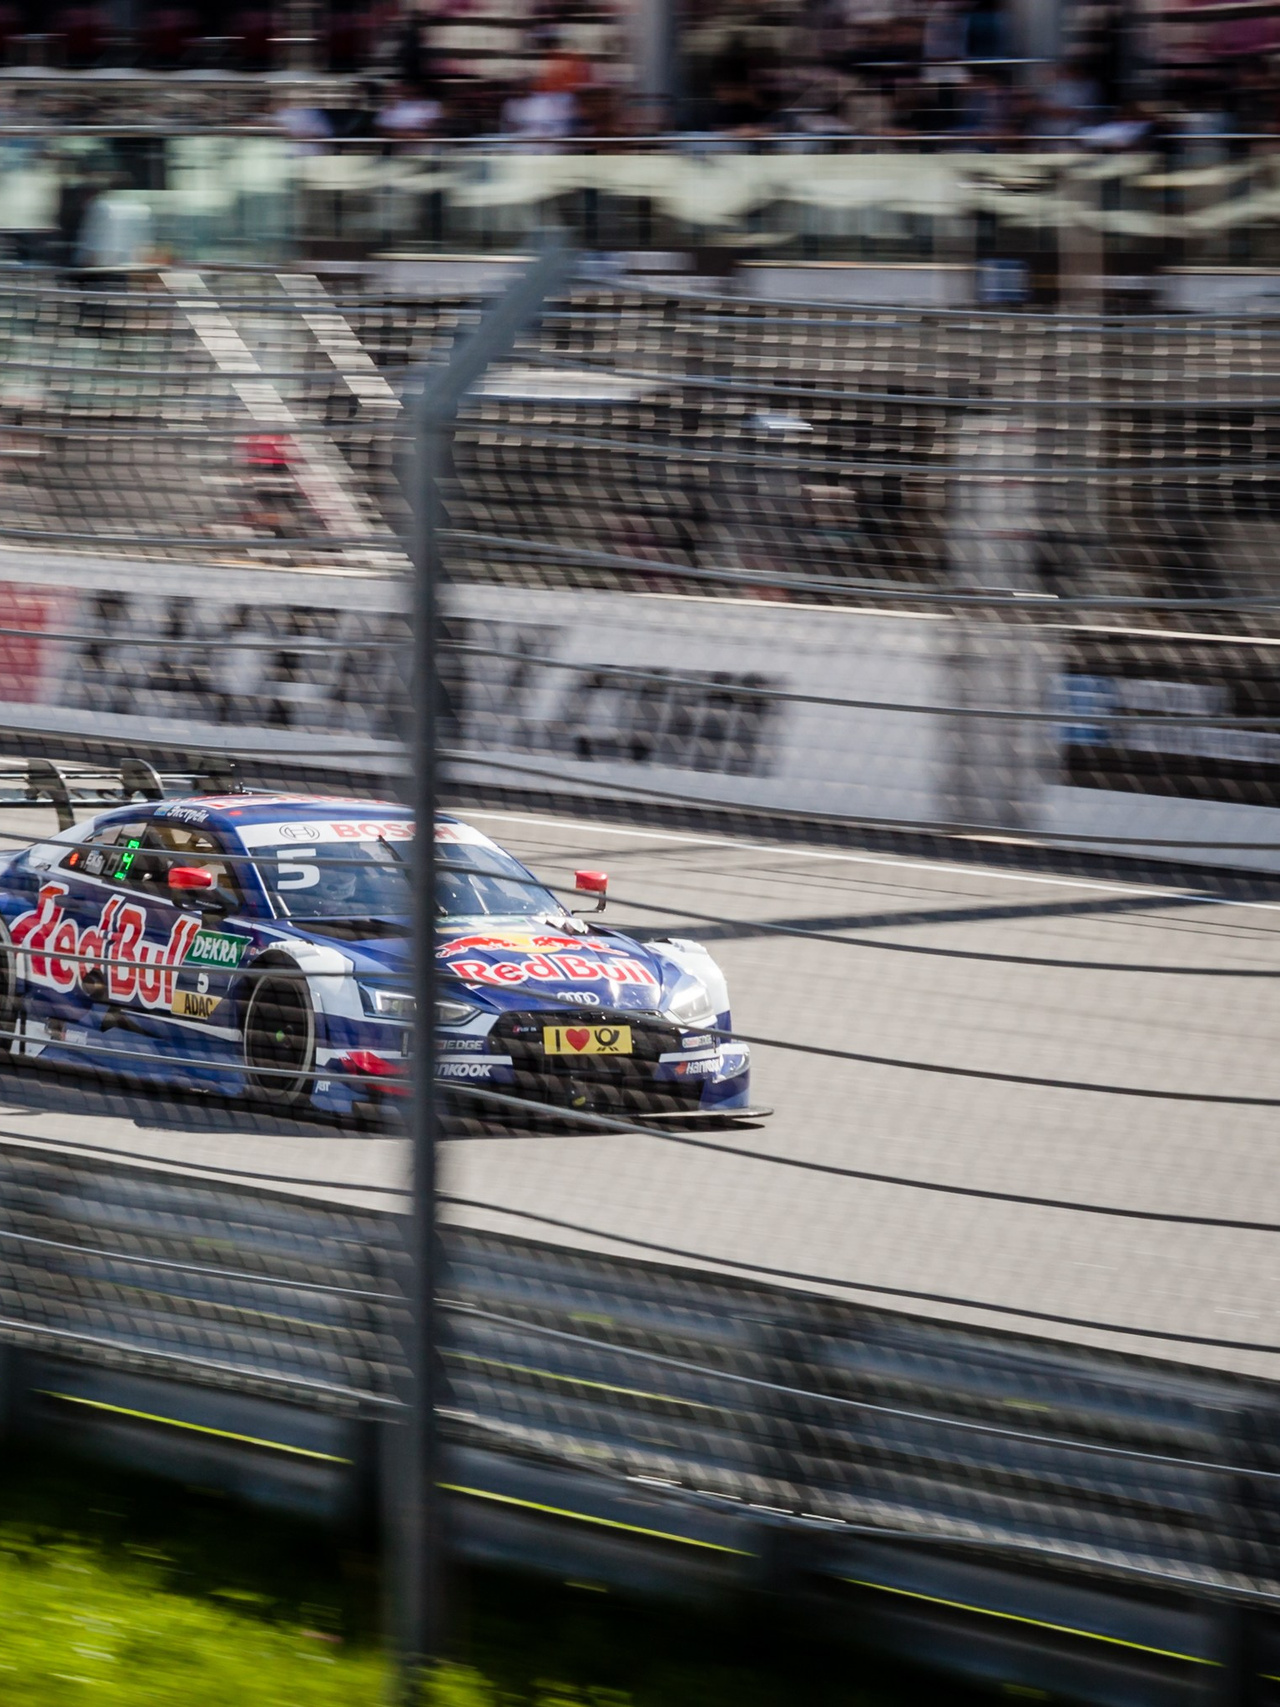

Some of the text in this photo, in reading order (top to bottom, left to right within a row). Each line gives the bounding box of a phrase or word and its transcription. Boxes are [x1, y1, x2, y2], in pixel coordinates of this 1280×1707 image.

[166, 805, 210, 823] Экстрём
[329, 823, 460, 840] BOSH
[277, 848, 320, 890] 5
[9, 881, 202, 1010] Red Bull
[192, 933, 238, 964] DEKRA
[197, 966, 209, 993] 5
[447, 954, 658, 989] Red Bull
[184, 993, 213, 1017] ADAC
[448, 1041, 484, 1050] EDGE
